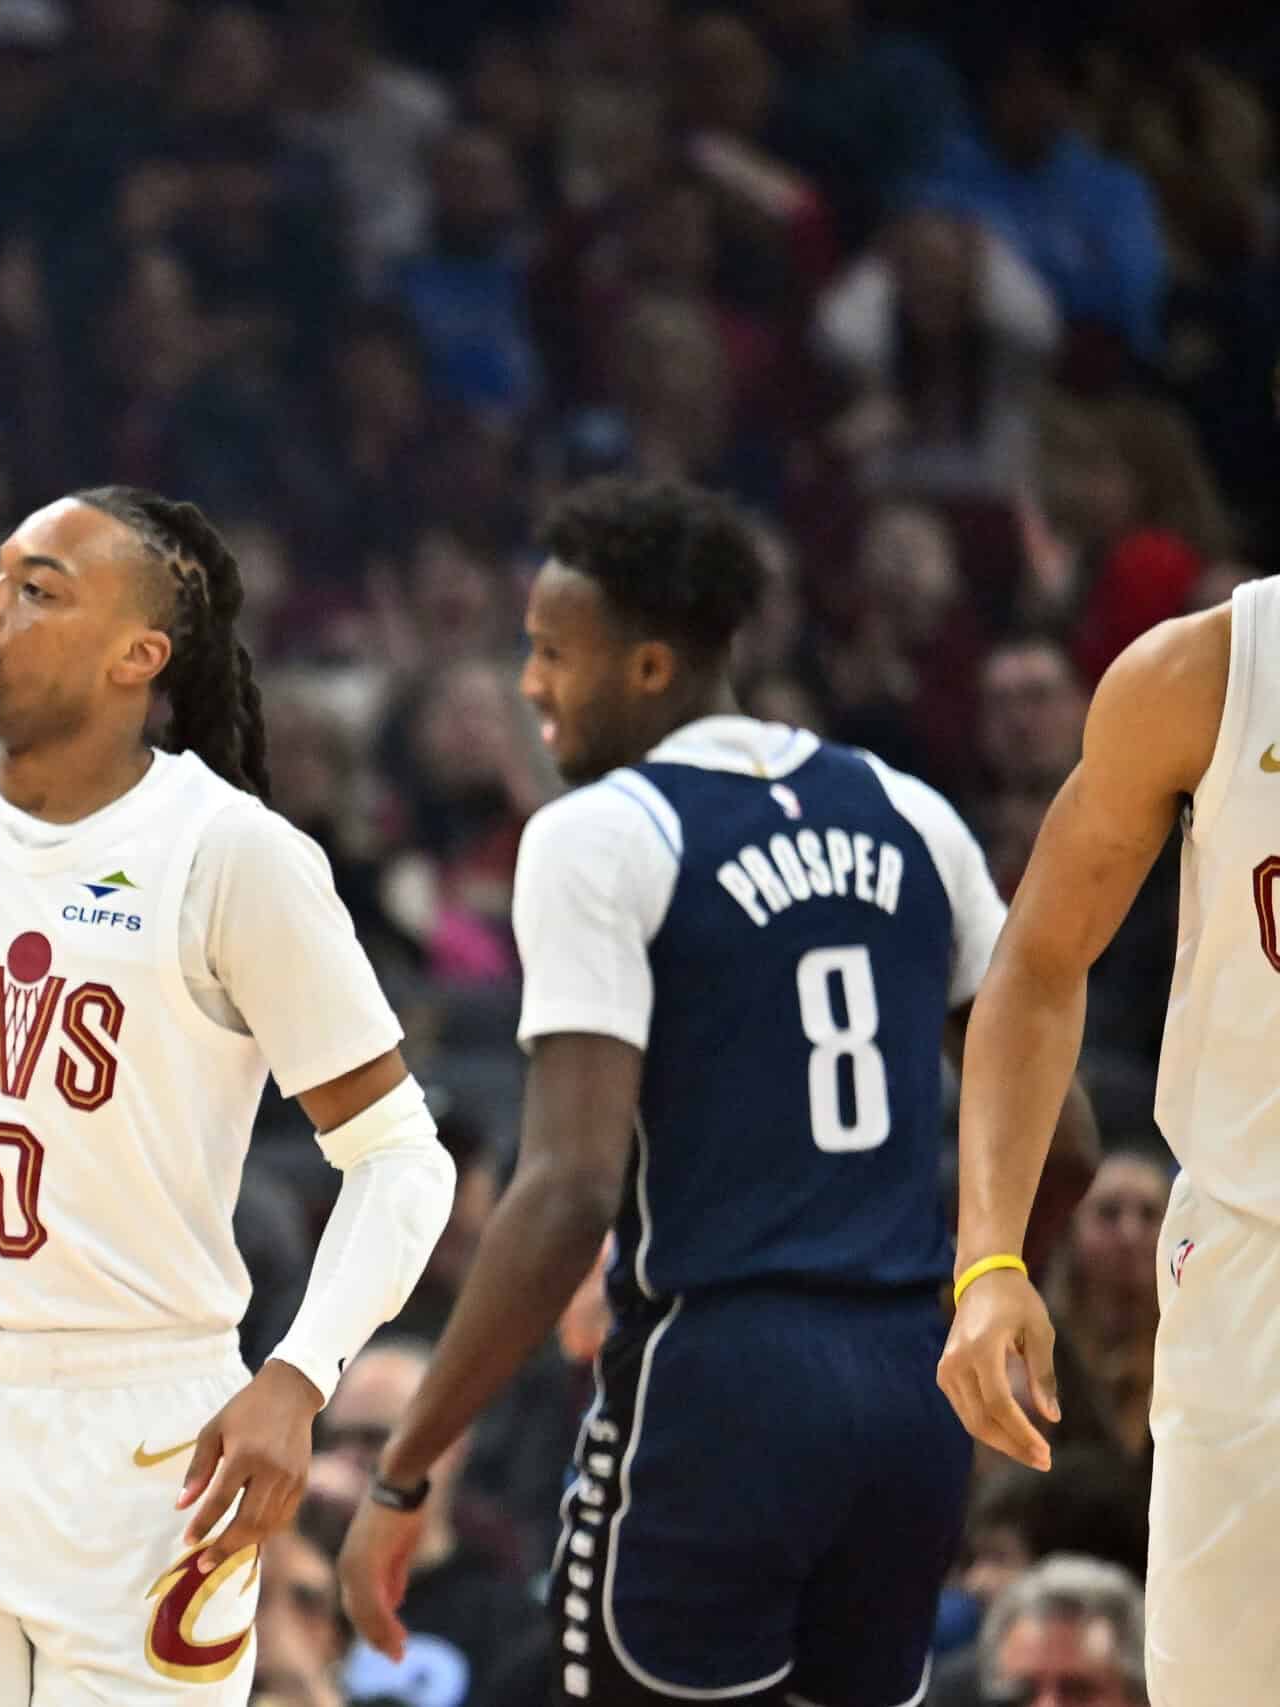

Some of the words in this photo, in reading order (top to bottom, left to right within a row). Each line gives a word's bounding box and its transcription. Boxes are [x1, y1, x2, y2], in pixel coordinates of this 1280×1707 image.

[62, 905, 141, 931] CLIFFS
[717, 828, 903, 927] PROSPER
[796, 944, 891, 1153] 8
